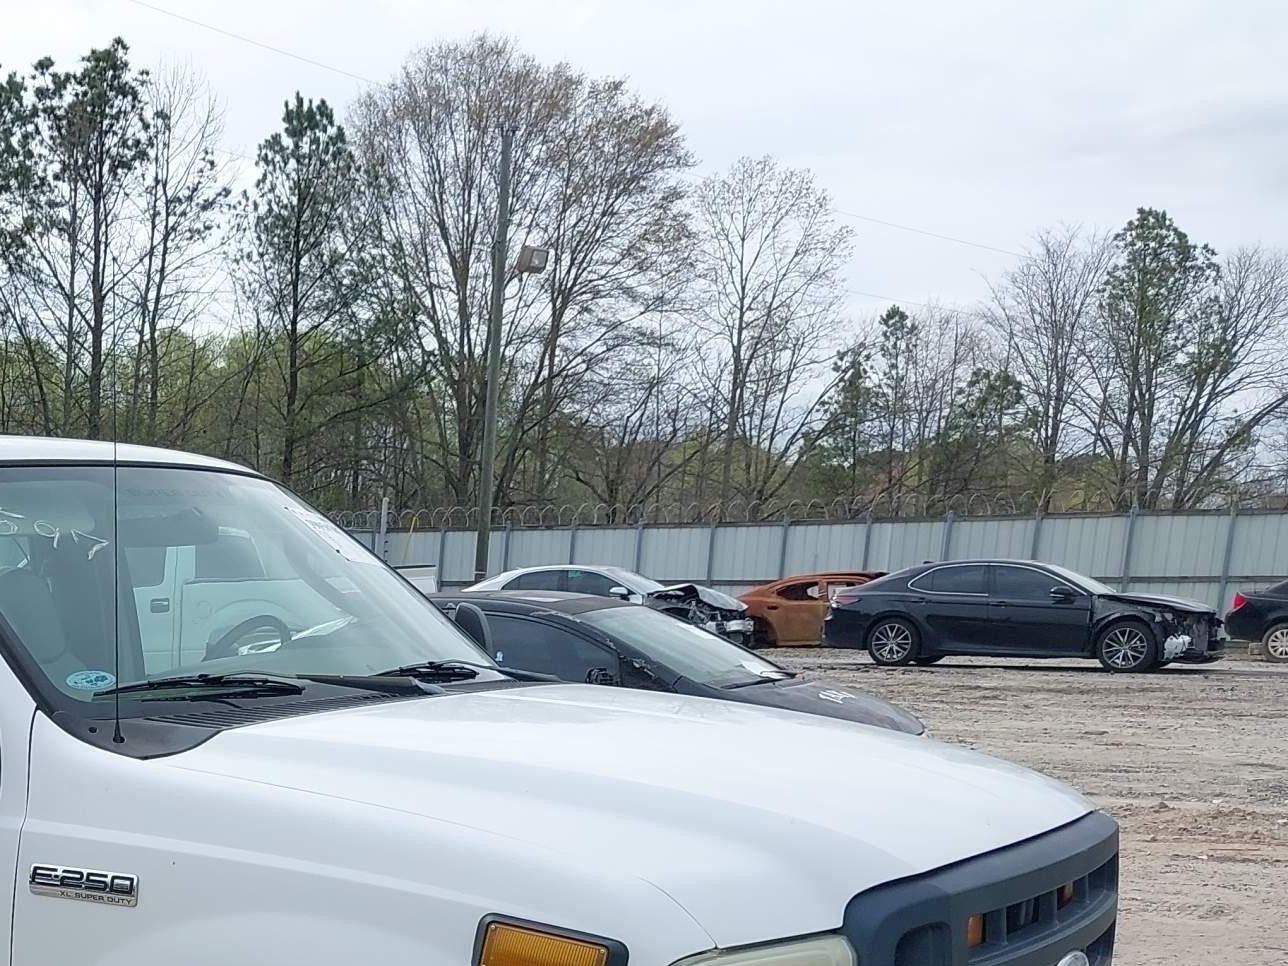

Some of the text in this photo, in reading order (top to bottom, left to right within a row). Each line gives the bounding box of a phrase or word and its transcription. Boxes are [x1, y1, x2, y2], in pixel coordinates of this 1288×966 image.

[31, 865, 135, 896] F-250
[74, 892, 105, 902] SUPER
[106, 896, 133, 905] DUTY
